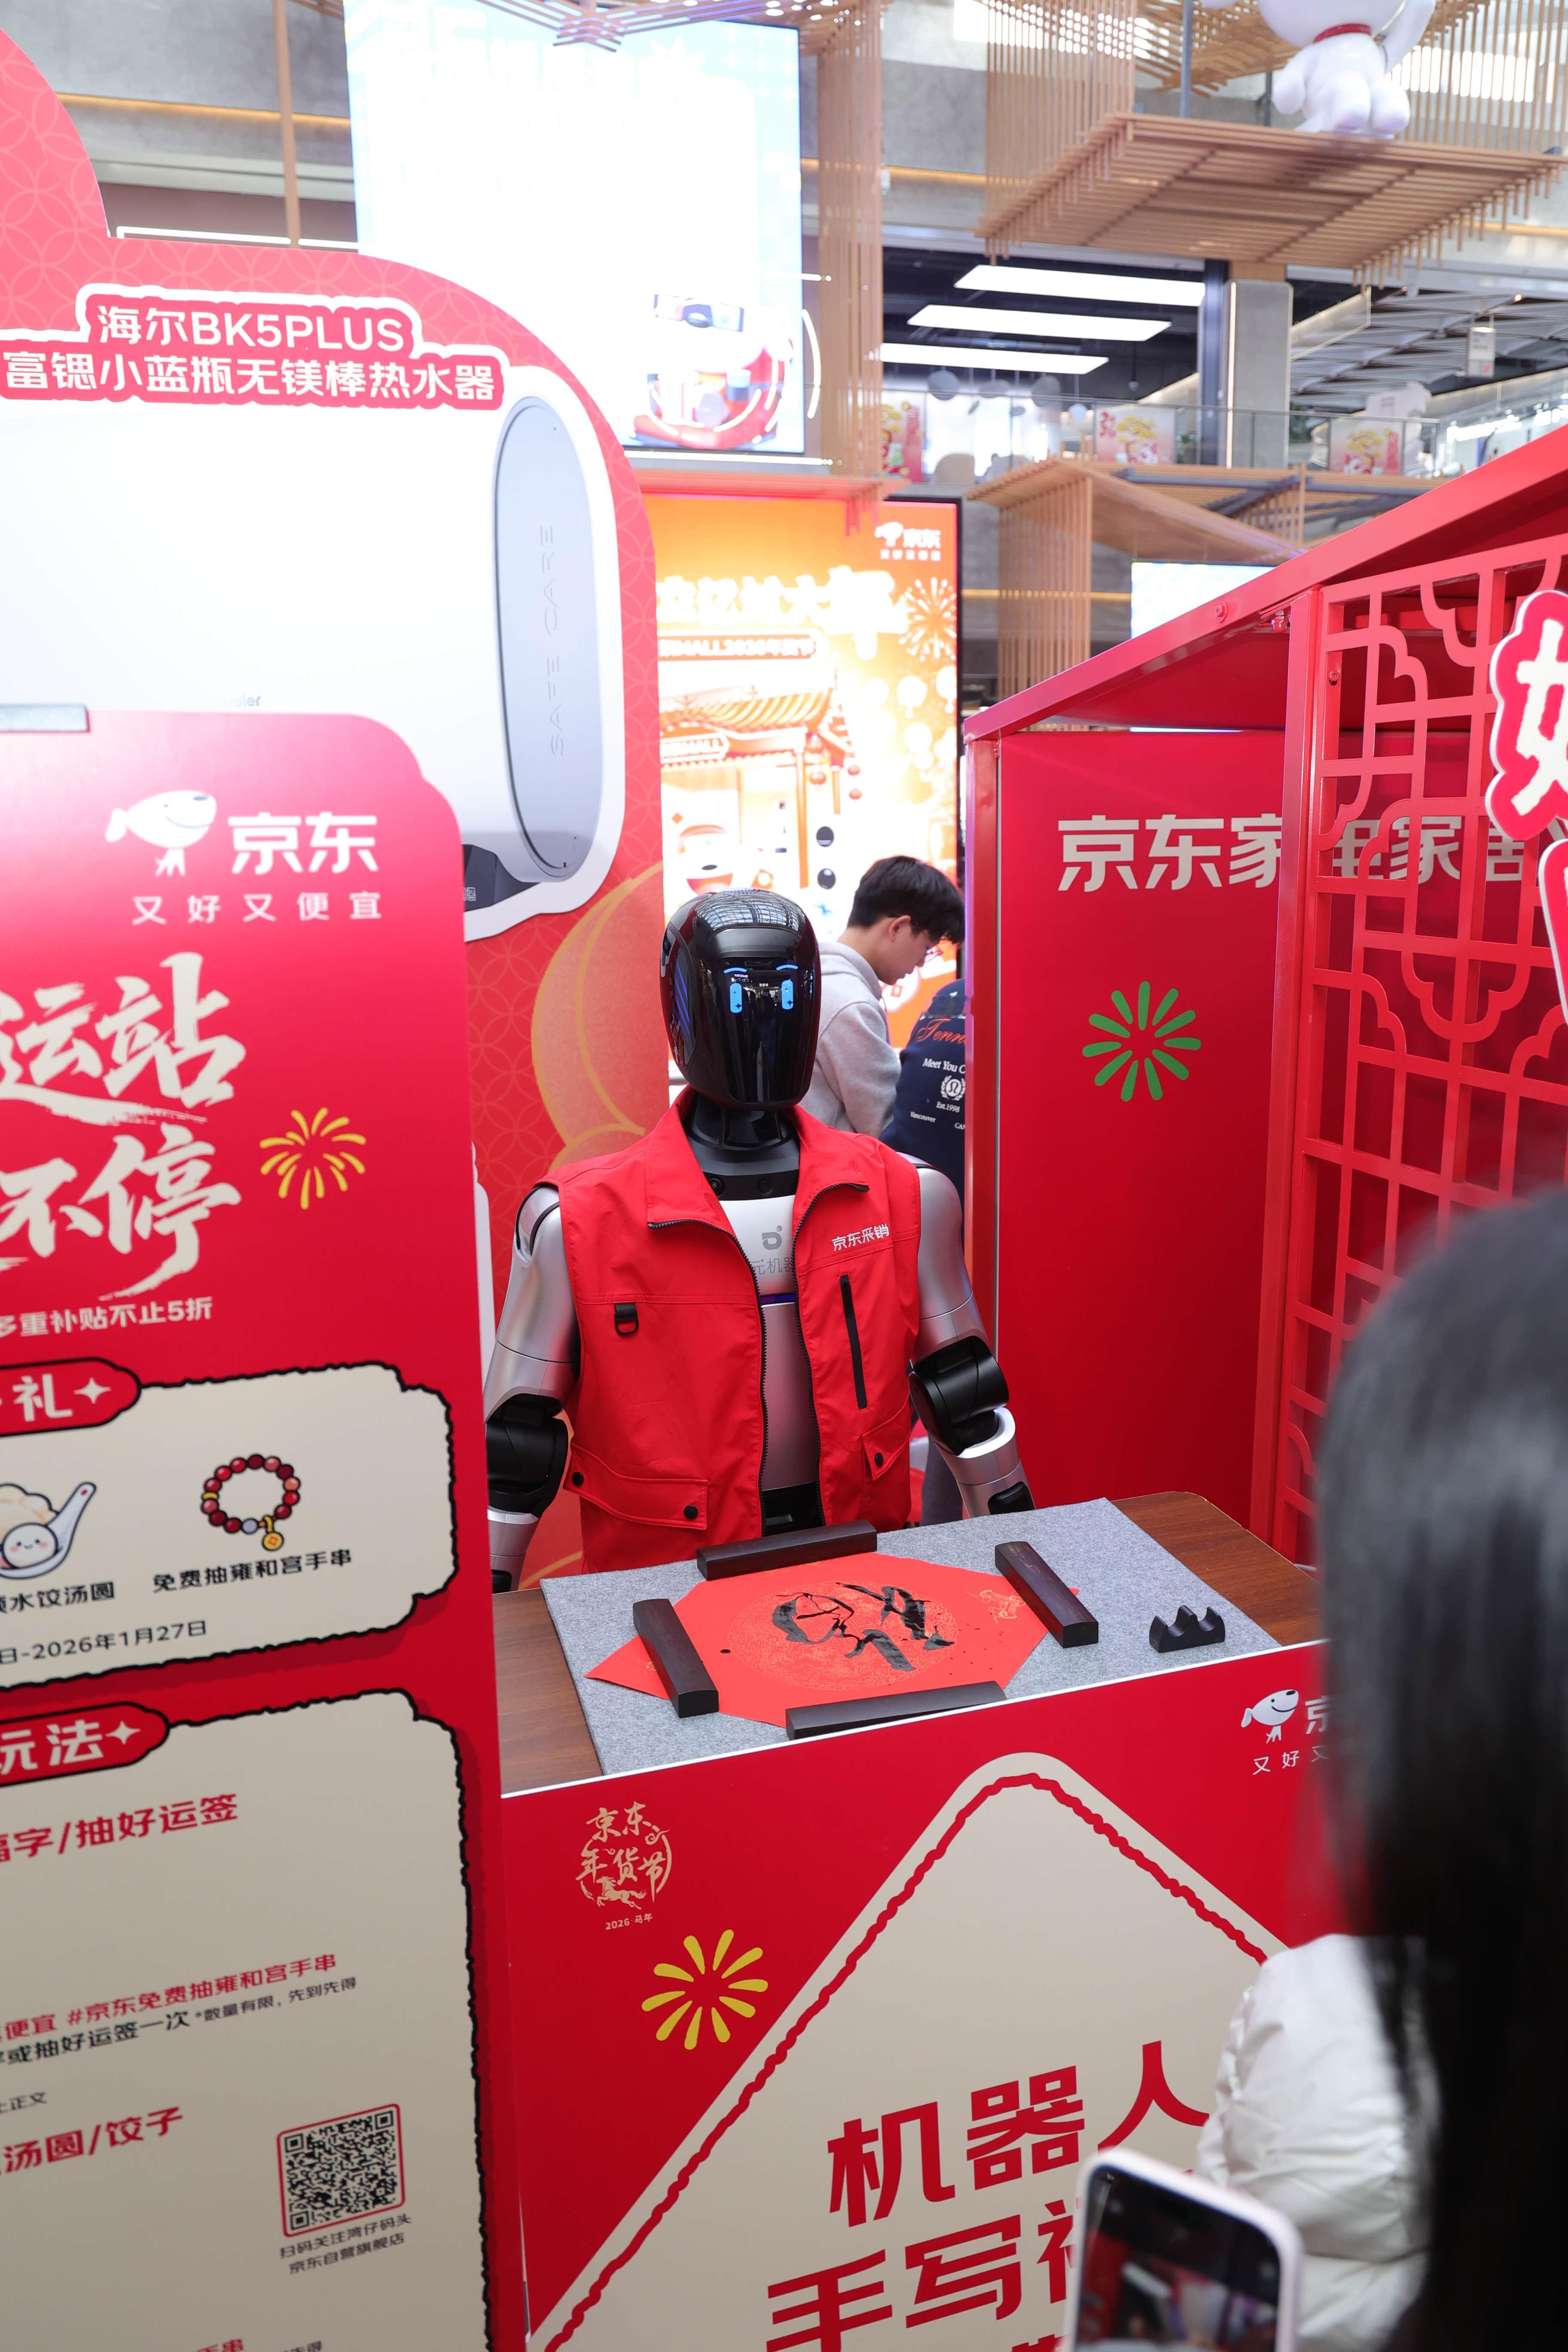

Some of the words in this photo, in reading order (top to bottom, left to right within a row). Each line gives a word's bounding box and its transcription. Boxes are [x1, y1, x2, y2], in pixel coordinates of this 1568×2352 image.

[96, 305, 404, 352] 海尔BK5PLUS
[3, 351, 495, 401] 富锶小蓝瓶无镁棒热水器
[540, 525, 557, 636] CARE
[547, 655, 564, 756] SAFE
[227, 812, 379, 875] 京东
[132, 891, 382, 925] 又好又便宜
[922, 1057, 941, 1069] Meet
[943, 1060, 958, 1072] You
[910, 1111, 936, 1122] Vancouver
[831, 1223, 890, 1252] 京东采销
[153, 1549, 352, 1594] 免费抽雍和宫手串
[827, 2040, 1210, 2228] 机器人
[279, 2213, 411, 2260] 扫码关注湾仔码头
[289, 2233, 404, 2275] 京东自营旗舰店
